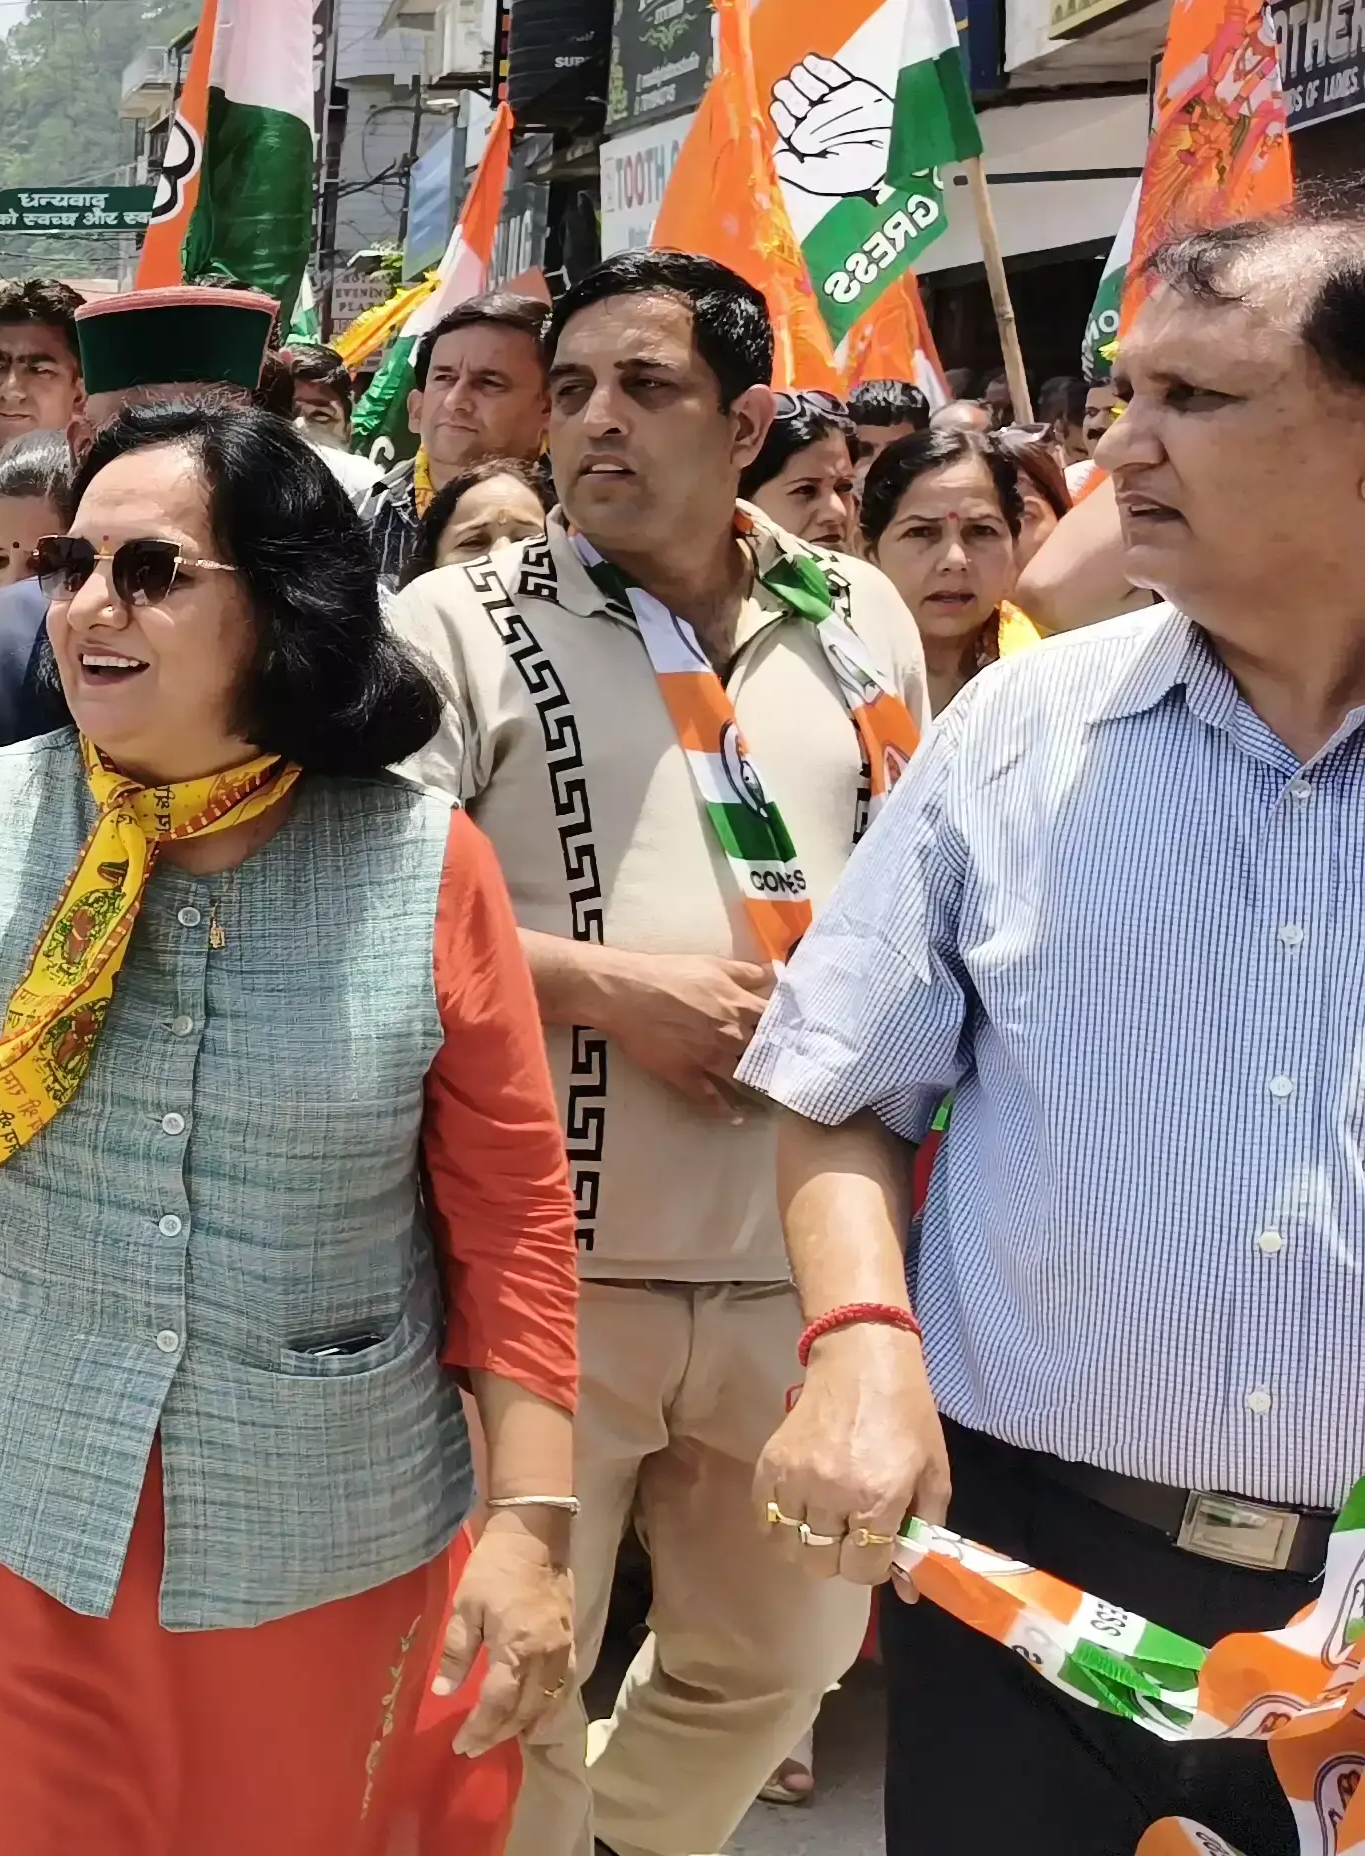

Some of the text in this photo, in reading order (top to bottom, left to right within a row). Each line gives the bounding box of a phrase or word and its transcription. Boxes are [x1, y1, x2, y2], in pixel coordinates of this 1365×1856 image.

[1306, 79, 1320, 109] OF
[615, 143, 666, 210] TOOTH
[17, 192, 110, 209] धन्यवाद
[82, 207, 119, 225] और
